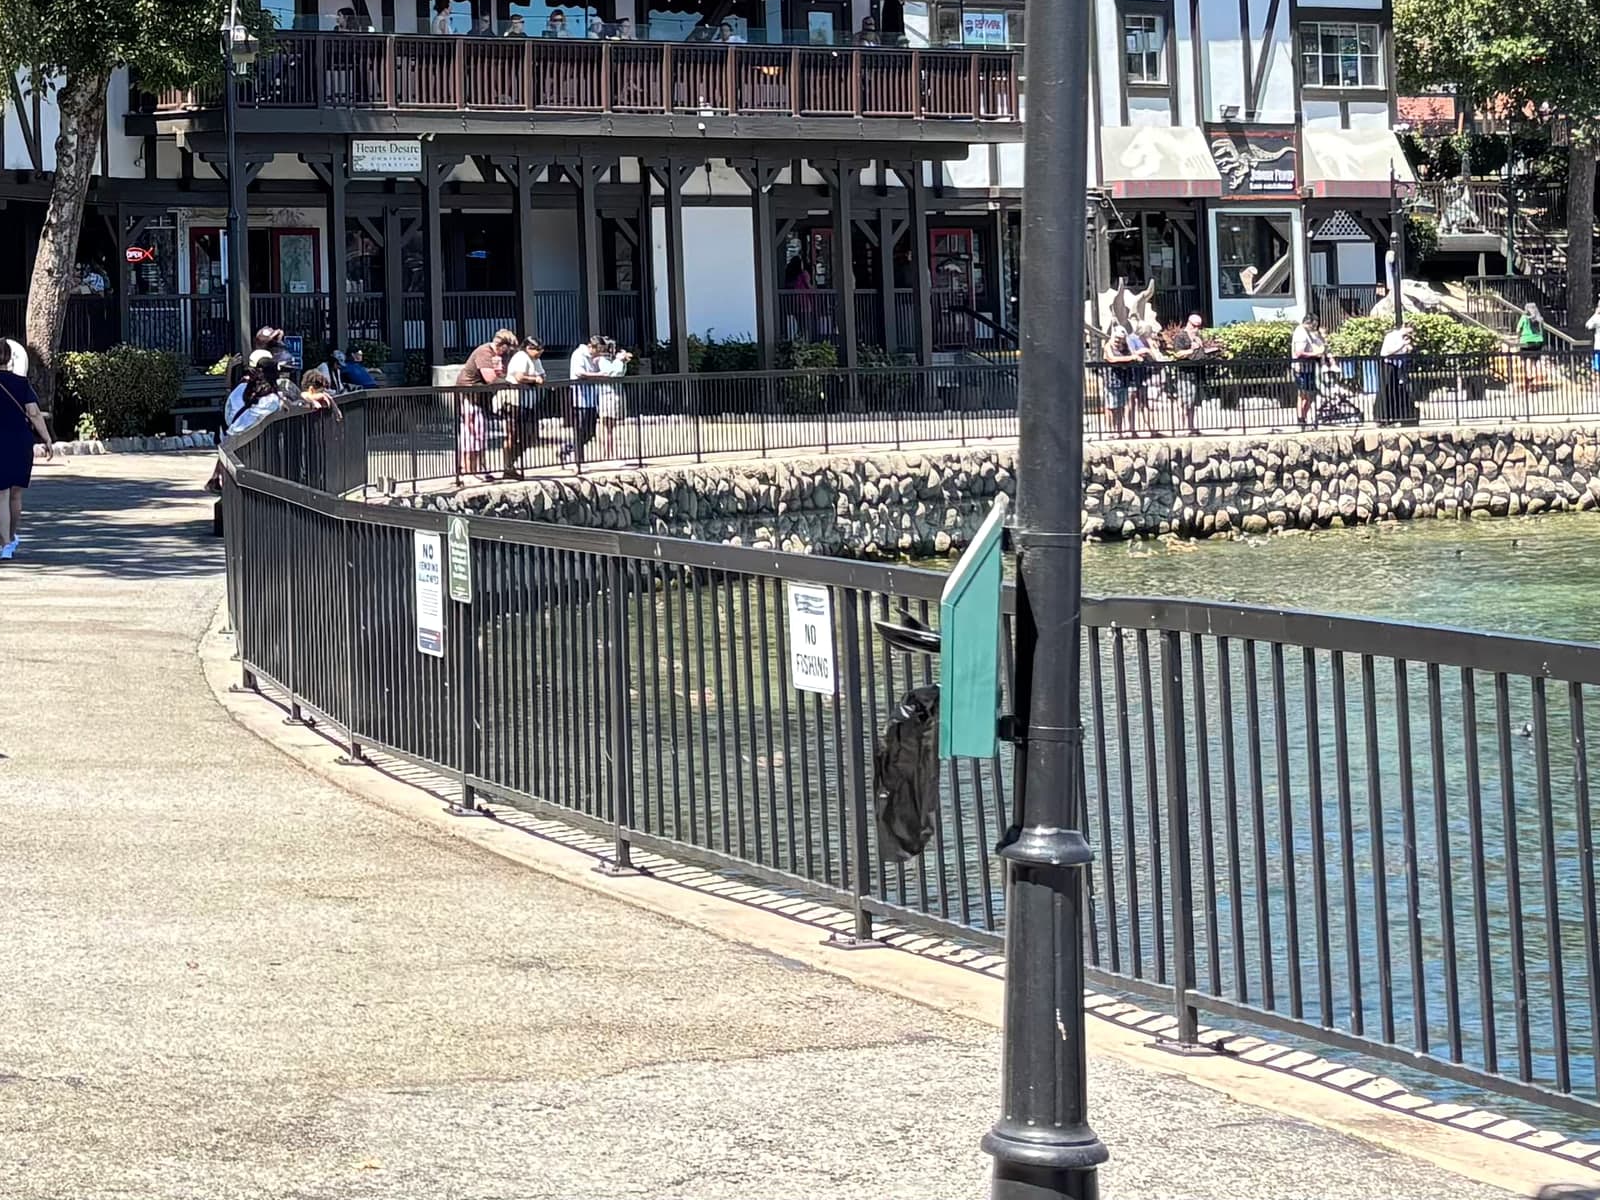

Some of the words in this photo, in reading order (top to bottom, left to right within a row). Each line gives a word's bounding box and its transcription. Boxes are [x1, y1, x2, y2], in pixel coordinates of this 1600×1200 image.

[356, 143, 387, 154] Hearts
[389, 143, 419, 154] Desire
[422, 543, 434, 560] NO
[805, 624, 817, 645] NO
[796, 653, 829, 679] FISHING
